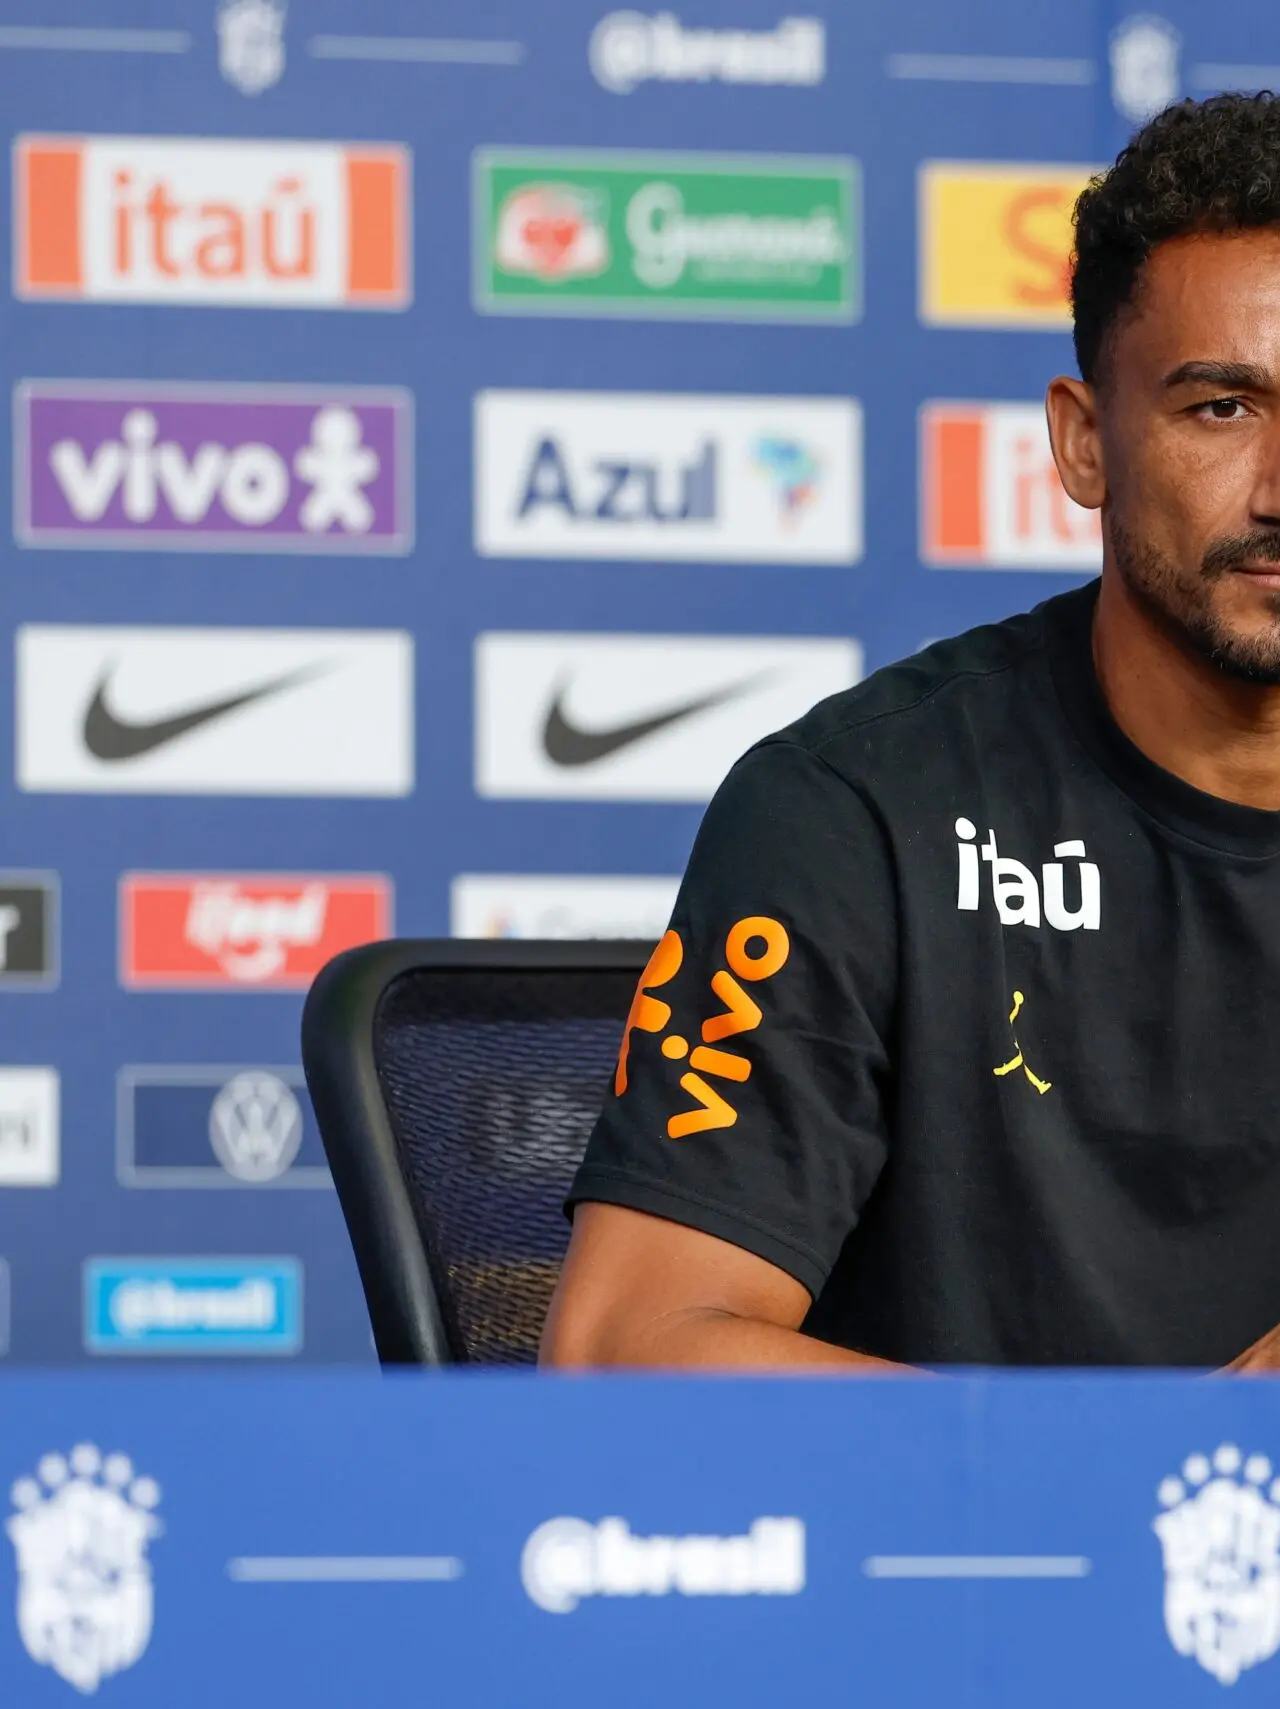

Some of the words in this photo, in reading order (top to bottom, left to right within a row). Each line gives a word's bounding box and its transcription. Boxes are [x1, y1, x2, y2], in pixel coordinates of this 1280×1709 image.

[112, 170, 316, 278] itaú
[50, 408, 289, 523] vivo
[514, 434, 717, 523] Azul
[955, 817, 1100, 932] itaú
[661, 916, 789, 1139] vivo
[522, 1516, 805, 1614] @brasil
